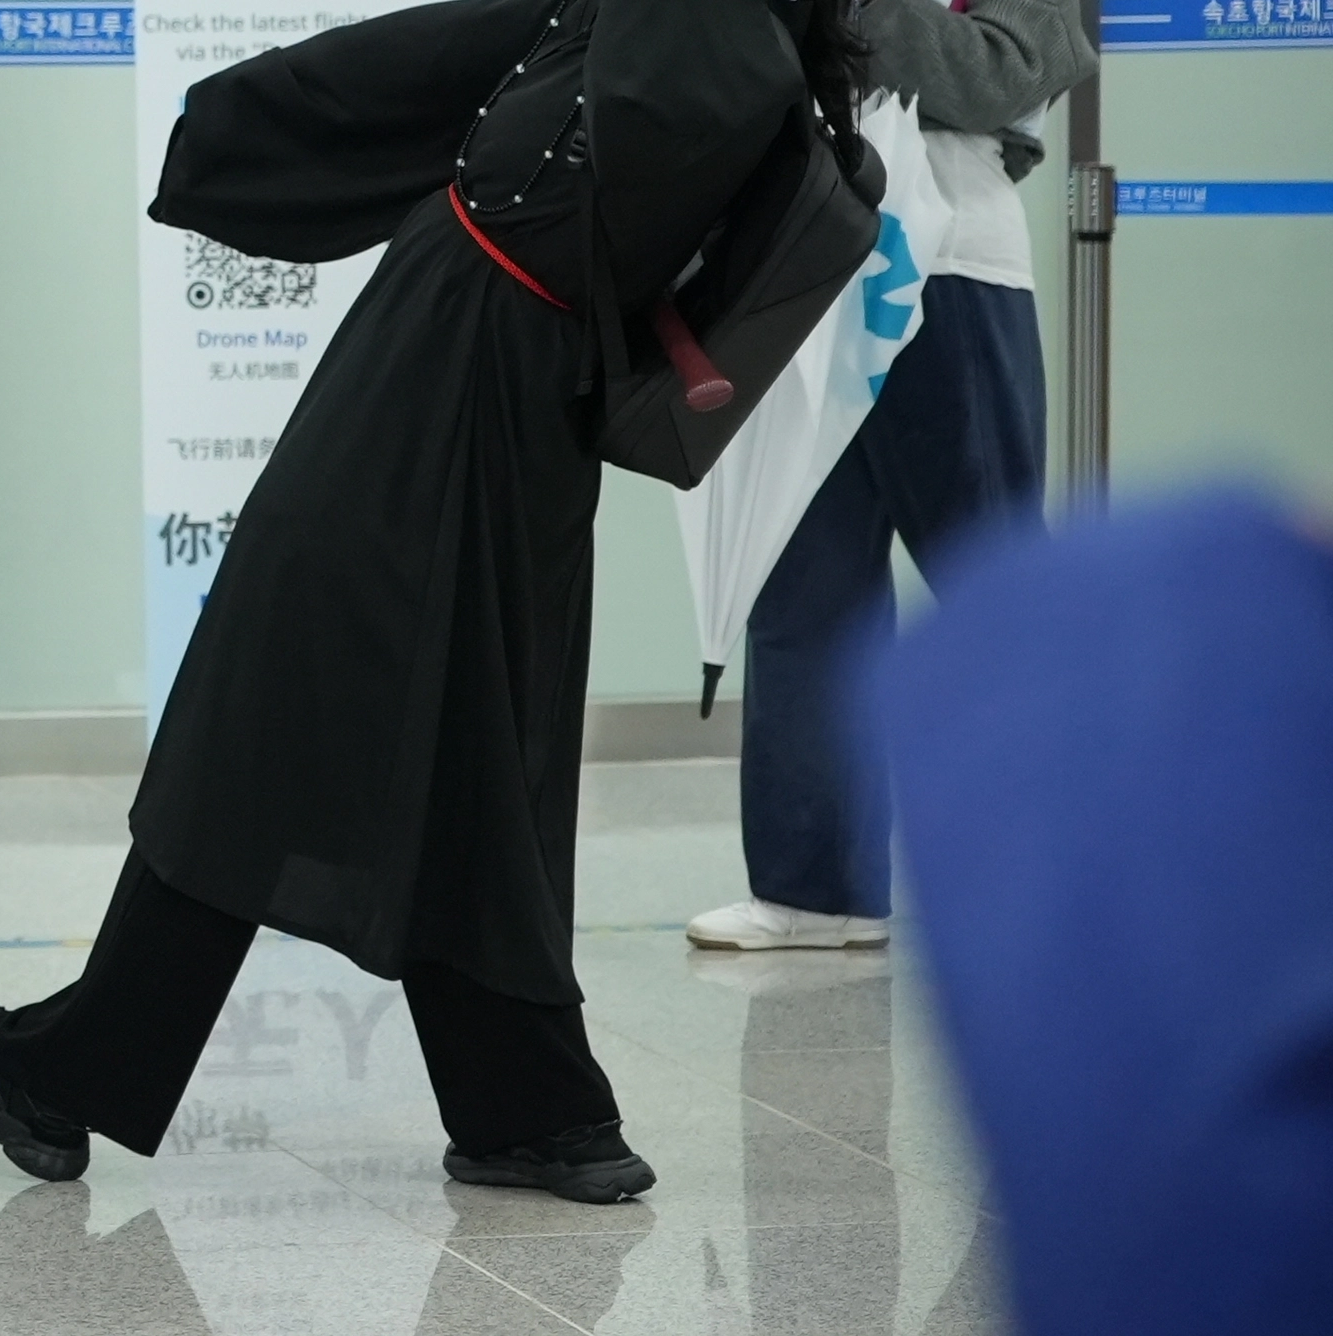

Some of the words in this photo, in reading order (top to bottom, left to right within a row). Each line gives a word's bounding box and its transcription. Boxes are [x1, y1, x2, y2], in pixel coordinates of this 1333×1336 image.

[142, 13, 207, 34] Check
[211, 12, 245, 33] the
[252, 11, 308, 33] latest
[176, 42, 206, 61] via
[212, 41, 246, 61] the
[197, 329, 258, 349] Drone
[264, 329, 309, 351] Map
